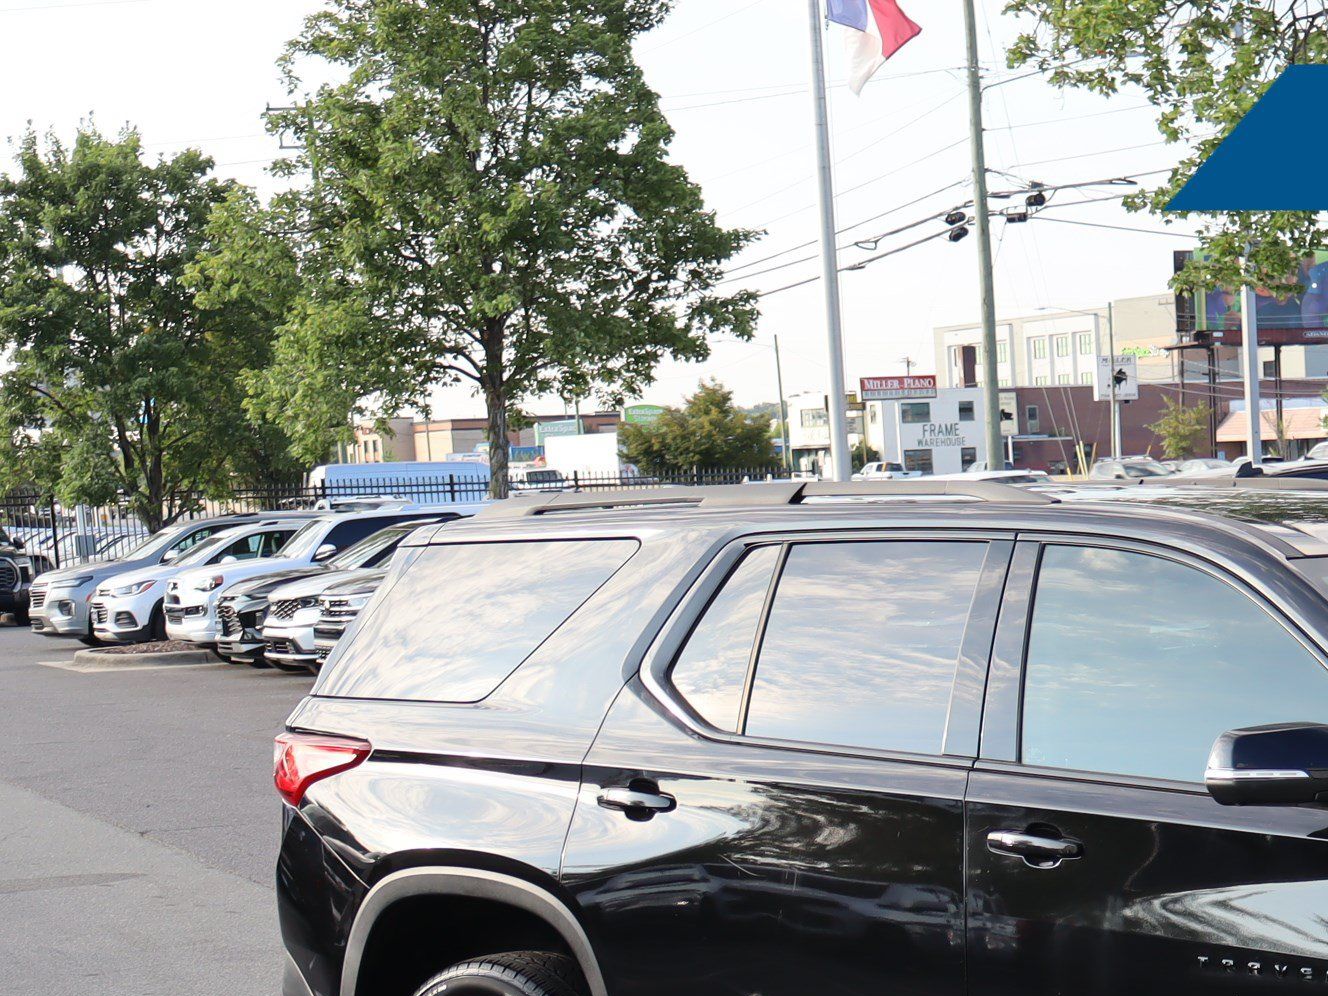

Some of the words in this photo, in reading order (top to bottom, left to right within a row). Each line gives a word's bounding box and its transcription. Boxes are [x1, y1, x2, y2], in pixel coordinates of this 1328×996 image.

[864, 378, 900, 390] MILLER
[903, 377, 934, 388] PIANO
[922, 423, 960, 438] FRAME
[917, 437, 966, 447] WAREHOUSE
